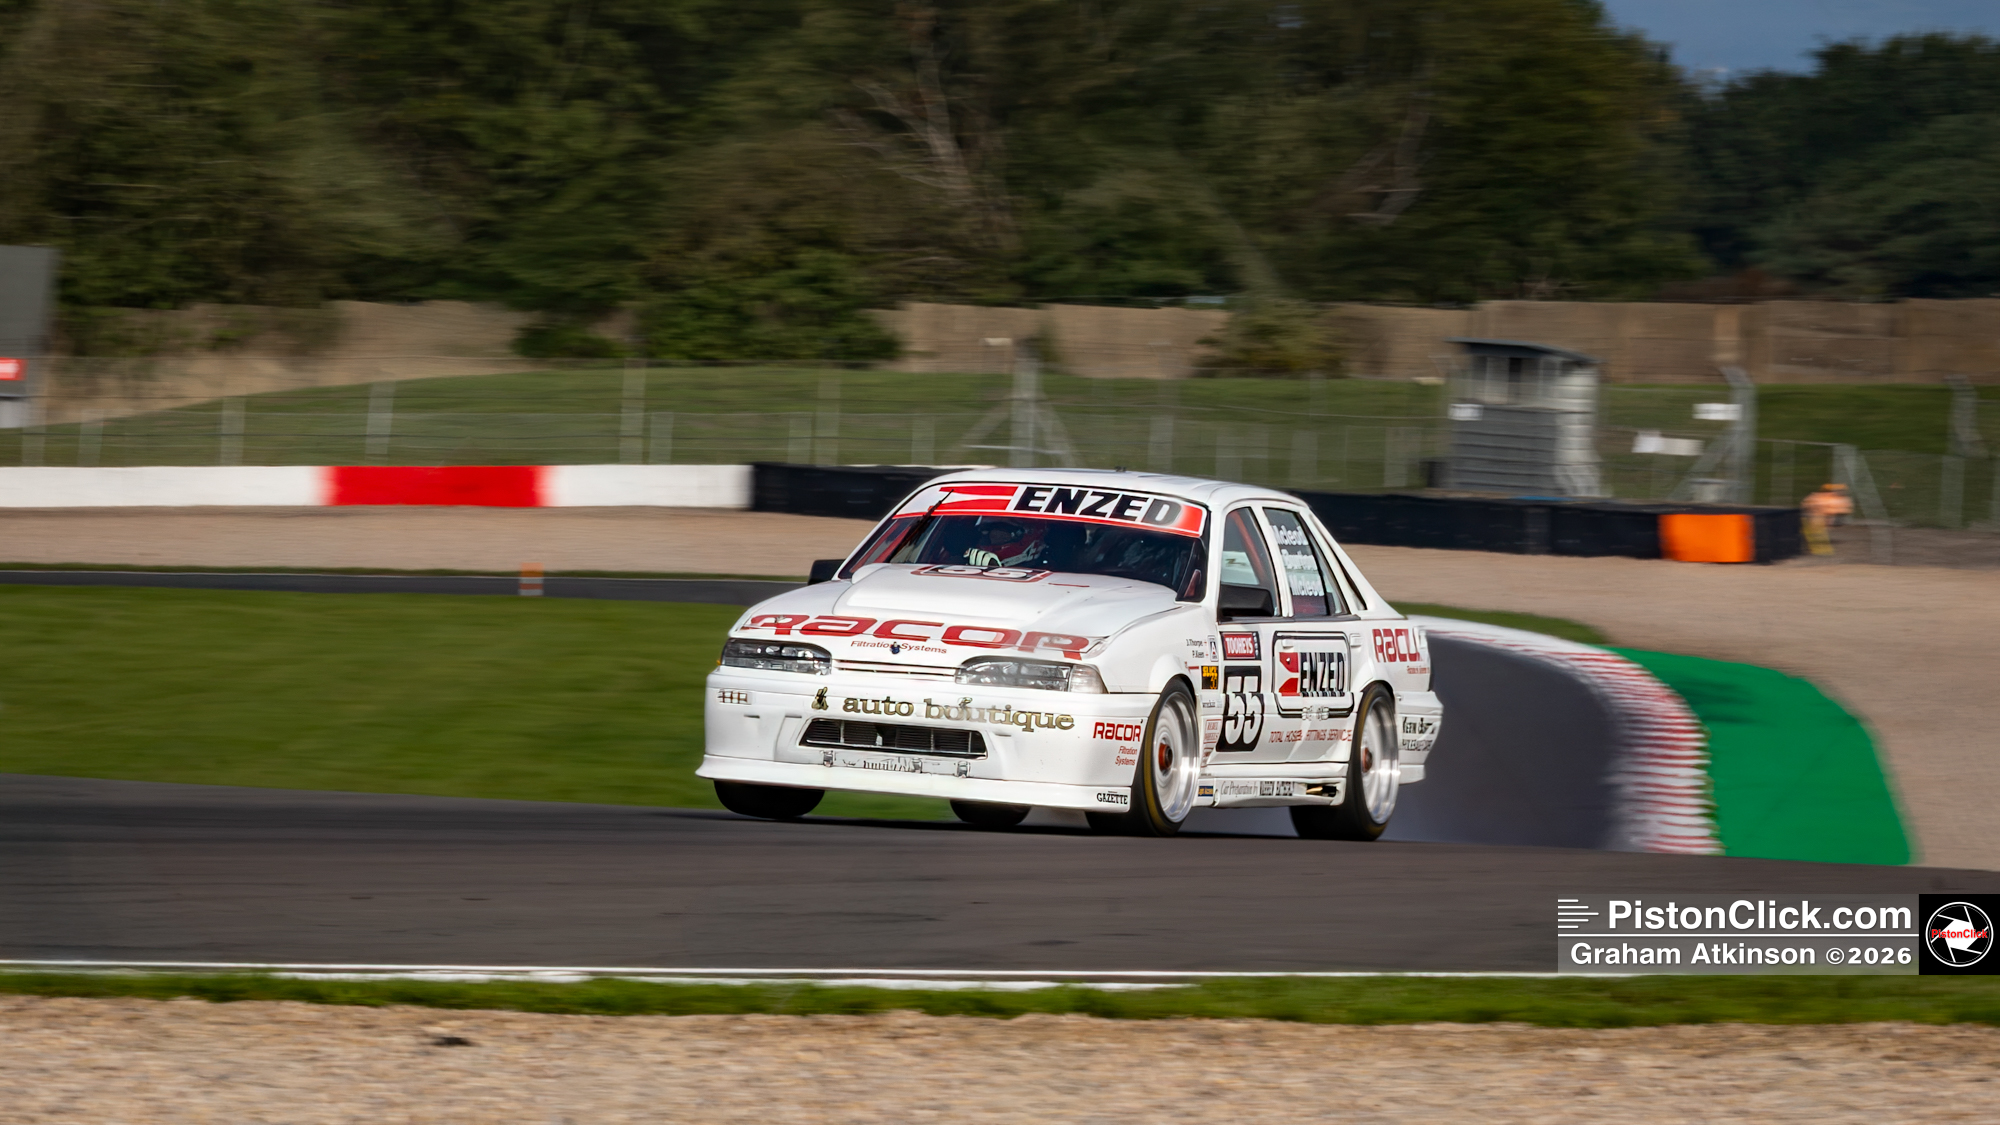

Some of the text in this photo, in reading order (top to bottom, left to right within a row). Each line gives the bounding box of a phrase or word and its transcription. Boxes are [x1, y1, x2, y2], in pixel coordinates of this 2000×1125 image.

[1013, 486, 1182, 526] ENZED
[750, 614, 1090, 660] RACOR
[900, 642, 947, 654] Systems
[1300, 652, 1345, 697] ENZED
[842, 696, 1075, 732] auto boutique
[1224, 676, 1263, 744] 55
[1093, 722, 1142, 742] RACOR
[1115, 755, 1136, 766] Systems
[1118, 745, 1138, 755] Filtration
[1097, 793, 1128, 804] GAZETTE
